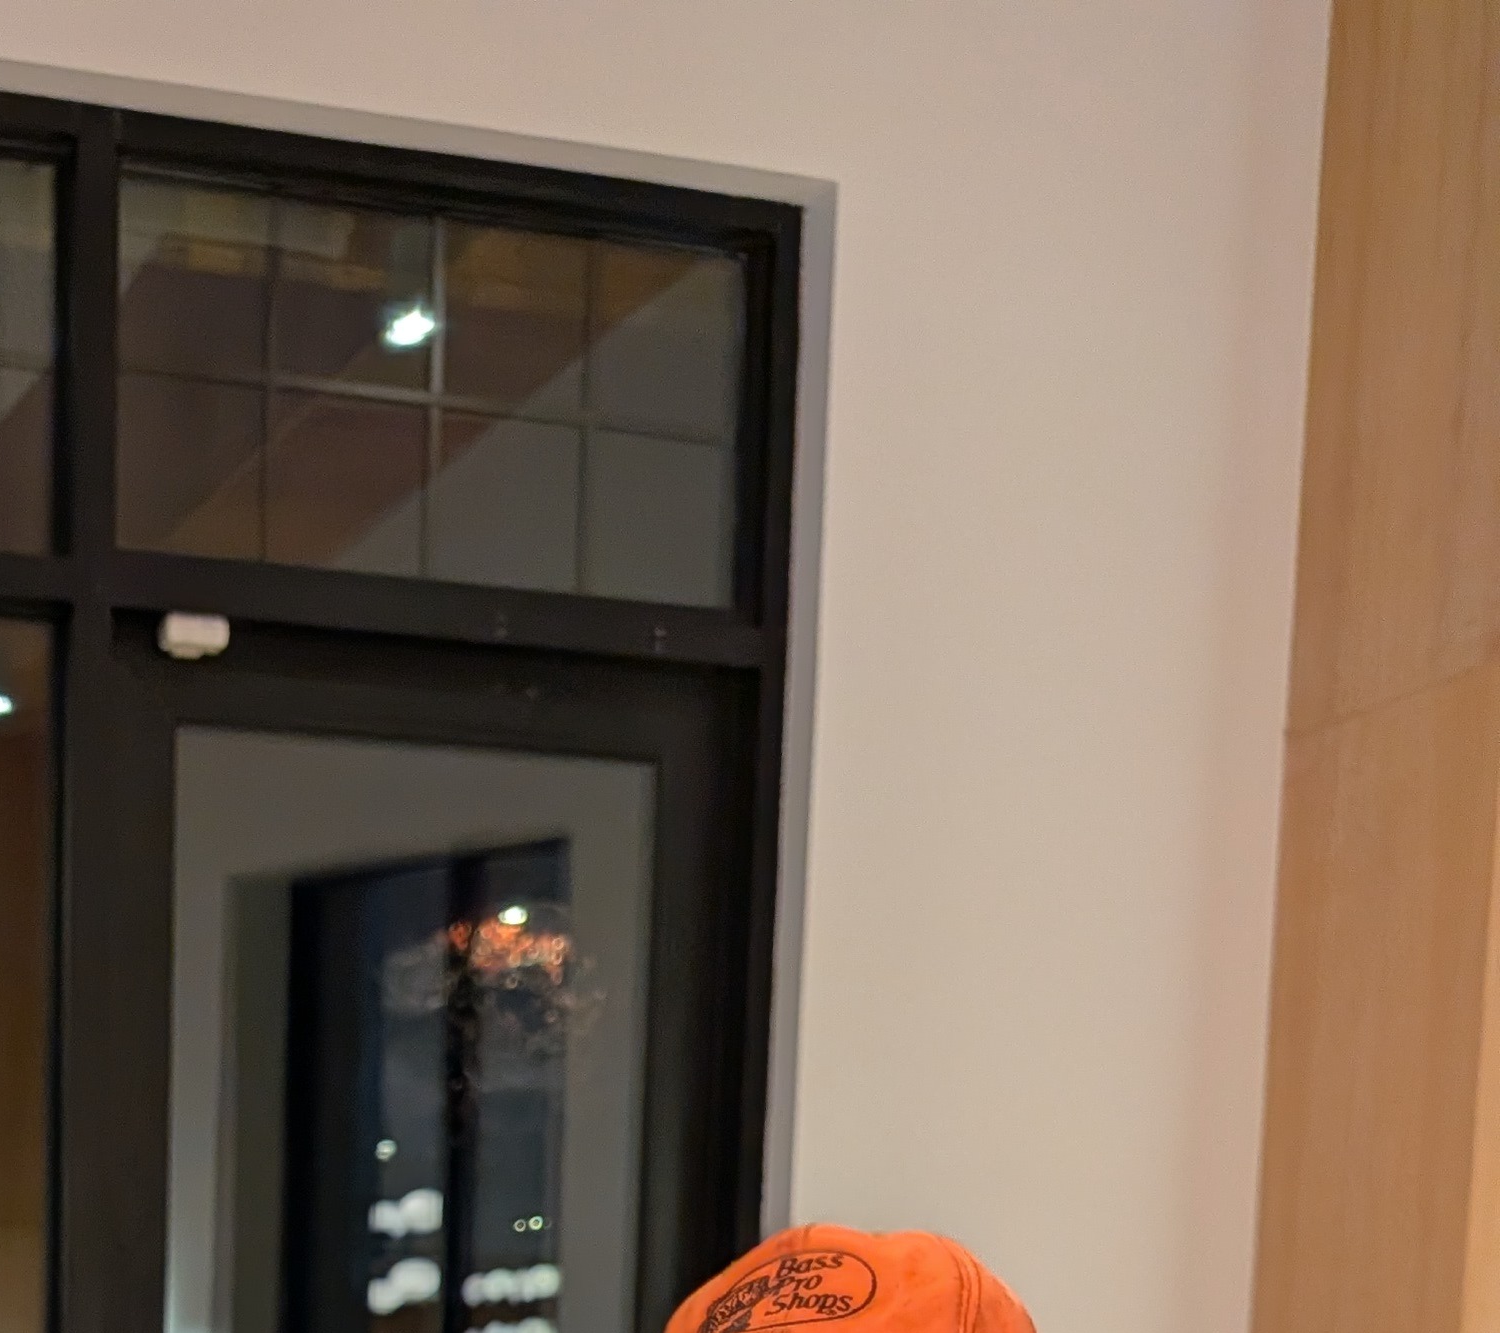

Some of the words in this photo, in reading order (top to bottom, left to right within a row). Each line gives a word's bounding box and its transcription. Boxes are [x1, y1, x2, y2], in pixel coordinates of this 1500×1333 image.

[775, 1253, 844, 1279] Bass
[774, 1274, 823, 1294] Pro
[764, 1292, 854, 1316] Shops
